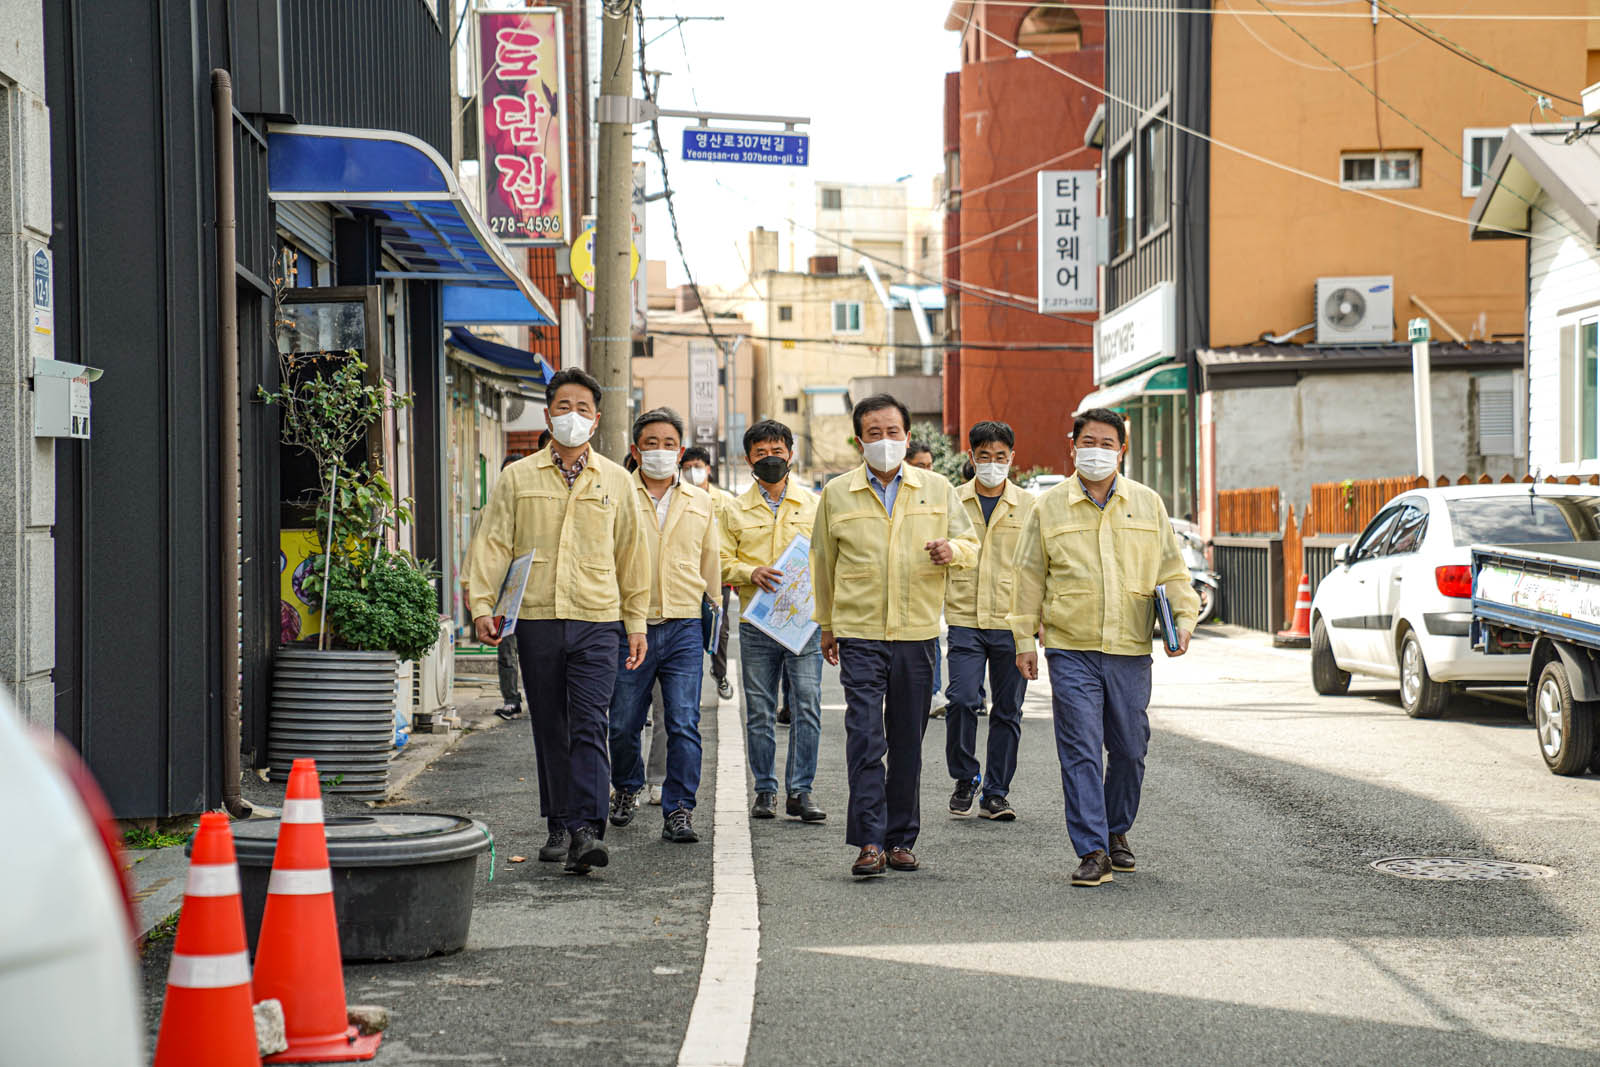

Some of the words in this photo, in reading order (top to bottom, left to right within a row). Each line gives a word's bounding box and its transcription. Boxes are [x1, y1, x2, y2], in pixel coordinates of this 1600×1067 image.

[494, 28, 546, 209] 토담집
[695, 133, 785, 152] 영산로307번길
[686, 149, 739, 161] Yeongsan-ro
[742, 152, 793, 165] 307beon-gil
[490, 216, 560, 233] 278-4596
[1056, 176, 1081, 291] 타파웨어
